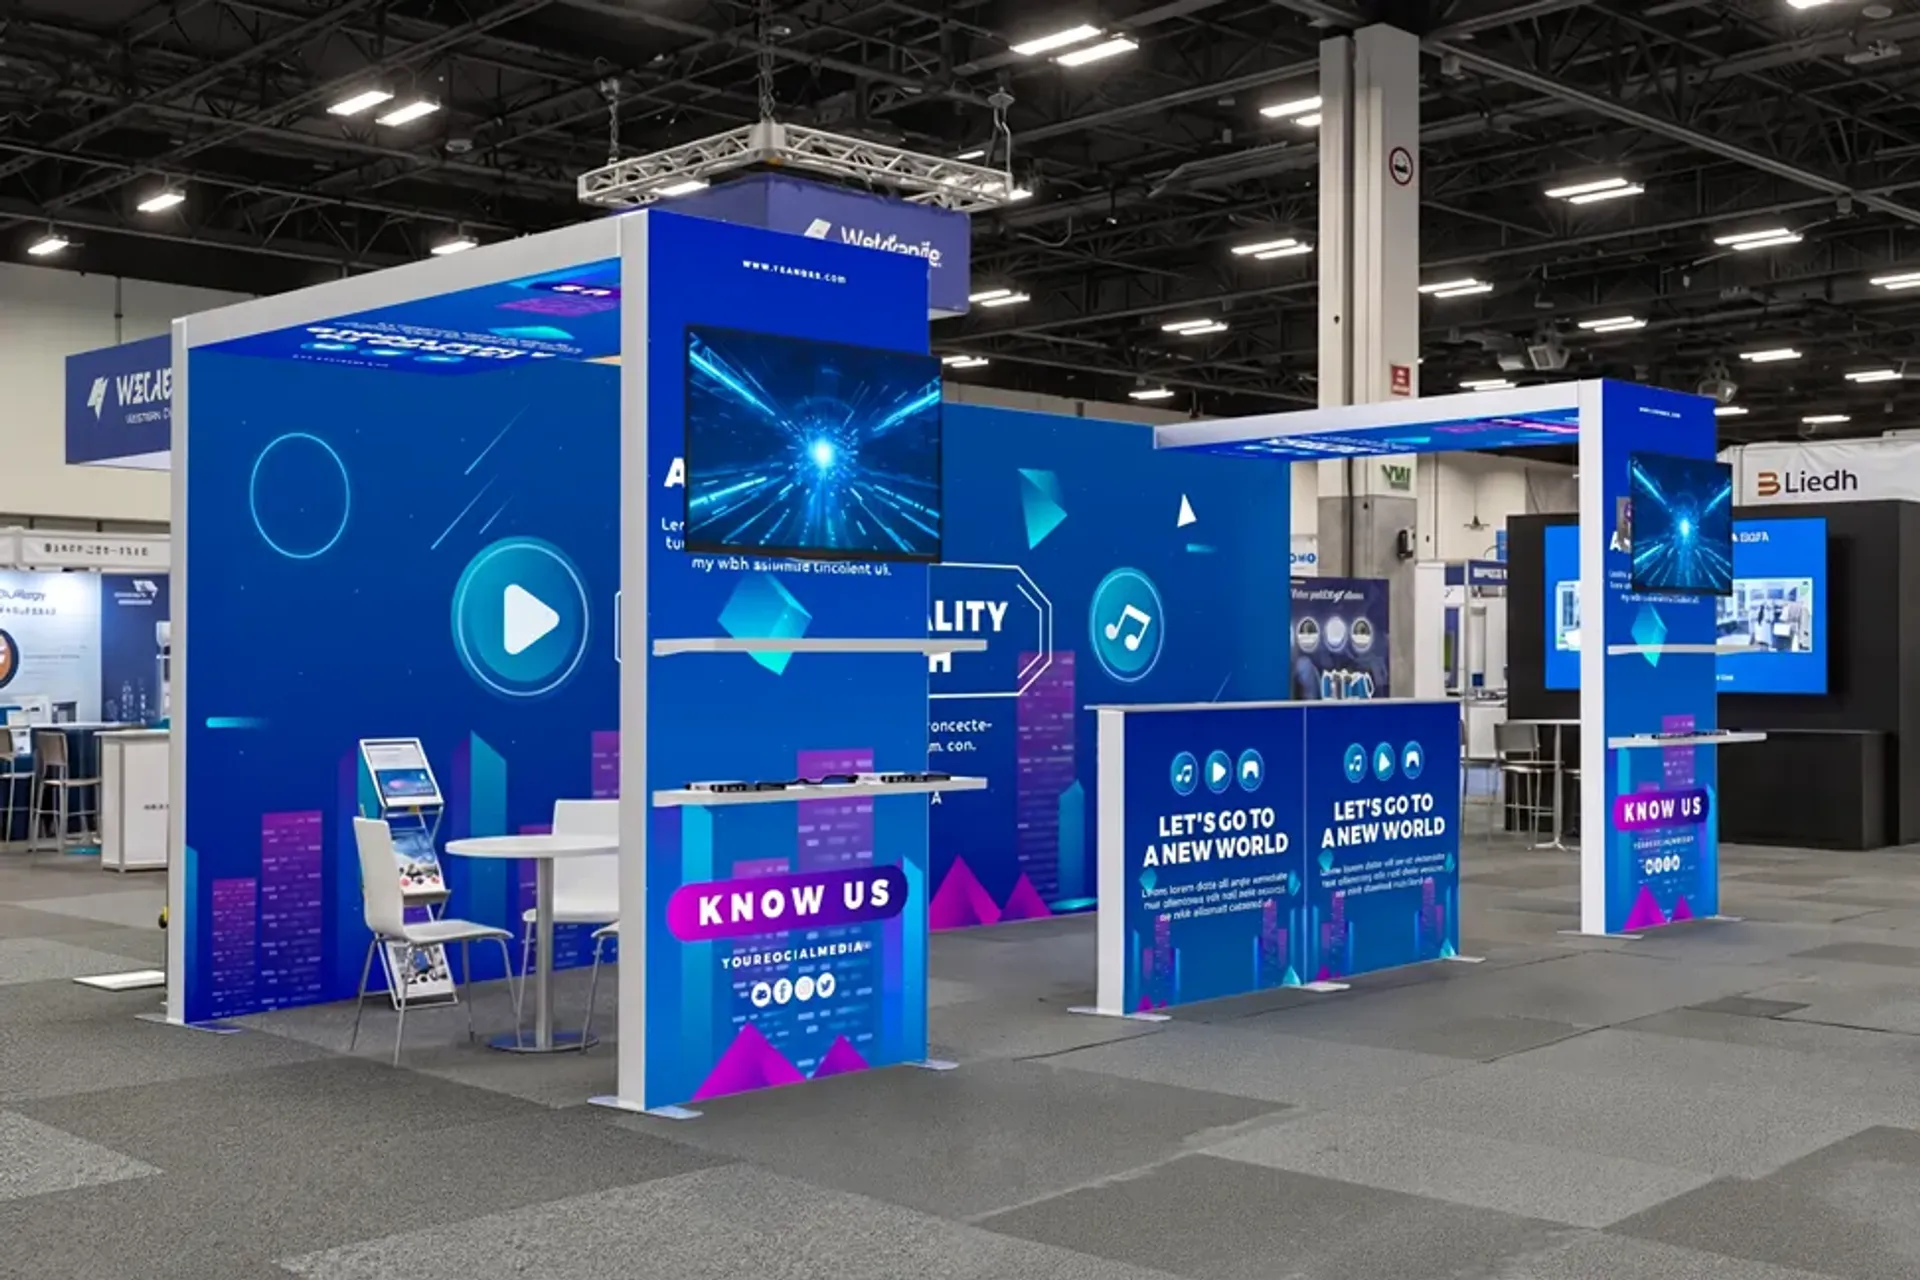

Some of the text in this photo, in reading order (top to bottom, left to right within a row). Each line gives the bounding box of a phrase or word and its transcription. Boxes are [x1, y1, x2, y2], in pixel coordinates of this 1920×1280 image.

[1785, 469, 1858, 493] Liedh
[692, 557, 714, 572] my
[1334, 793, 1433, 821] LET'S GO TO
[1624, 796, 1702, 822] KNOW US
[1159, 807, 1275, 837] LET'S GO TO
[1321, 816, 1445, 848] A NEW WORLD
[1143, 832, 1289, 867] A NEW WORLD
[699, 878, 890, 927] KNOW US
